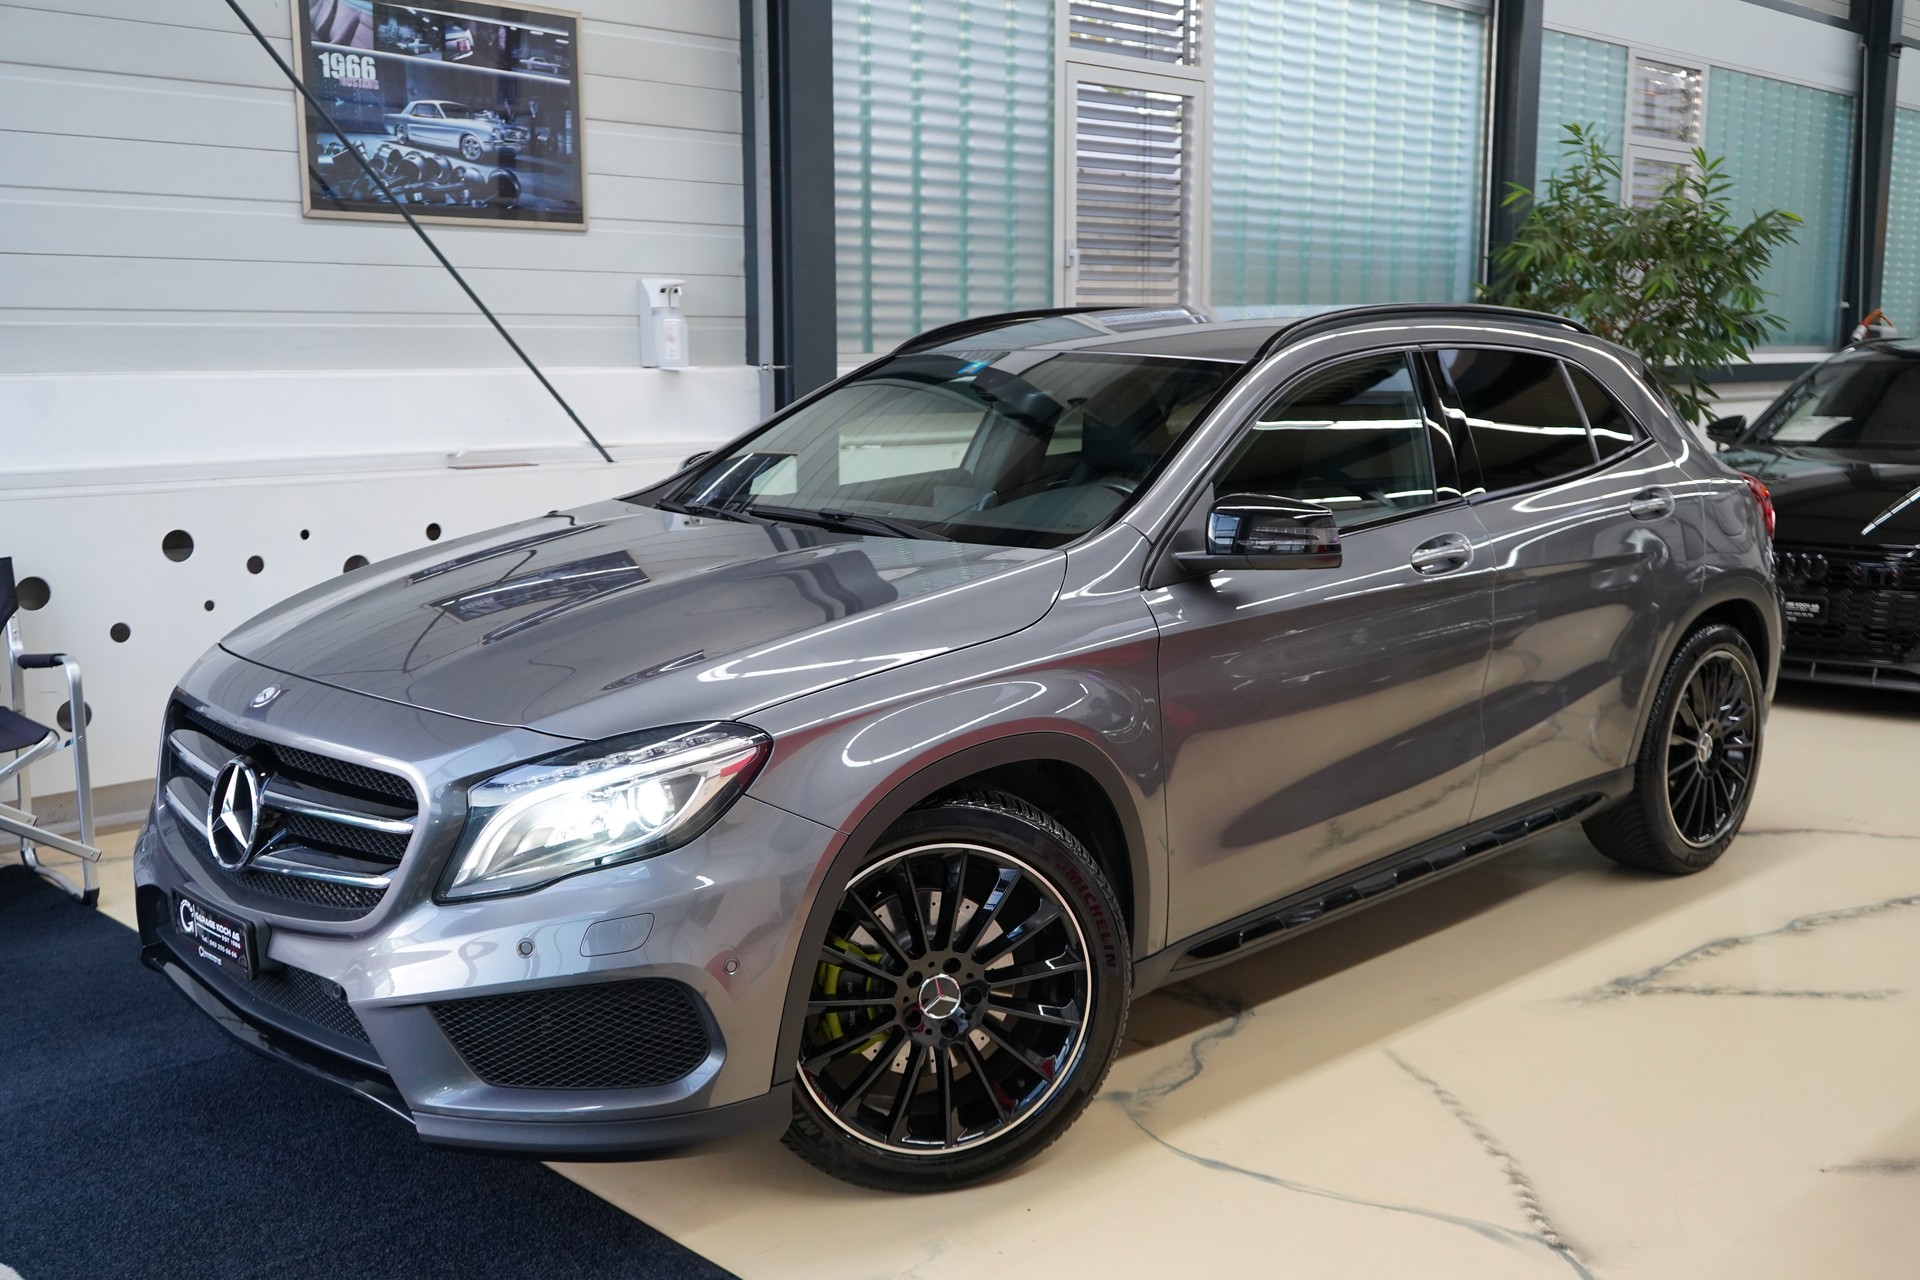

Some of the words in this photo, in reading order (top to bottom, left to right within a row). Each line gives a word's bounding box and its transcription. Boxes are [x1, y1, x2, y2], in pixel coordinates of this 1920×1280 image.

[318, 51, 377, 81] 1966
[338, 76, 380, 90] MUSTANG
[1065, 868, 1117, 968] MICHELIN
[215, 923, 232, 938] KOCH
[232, 931, 240, 942] AG
